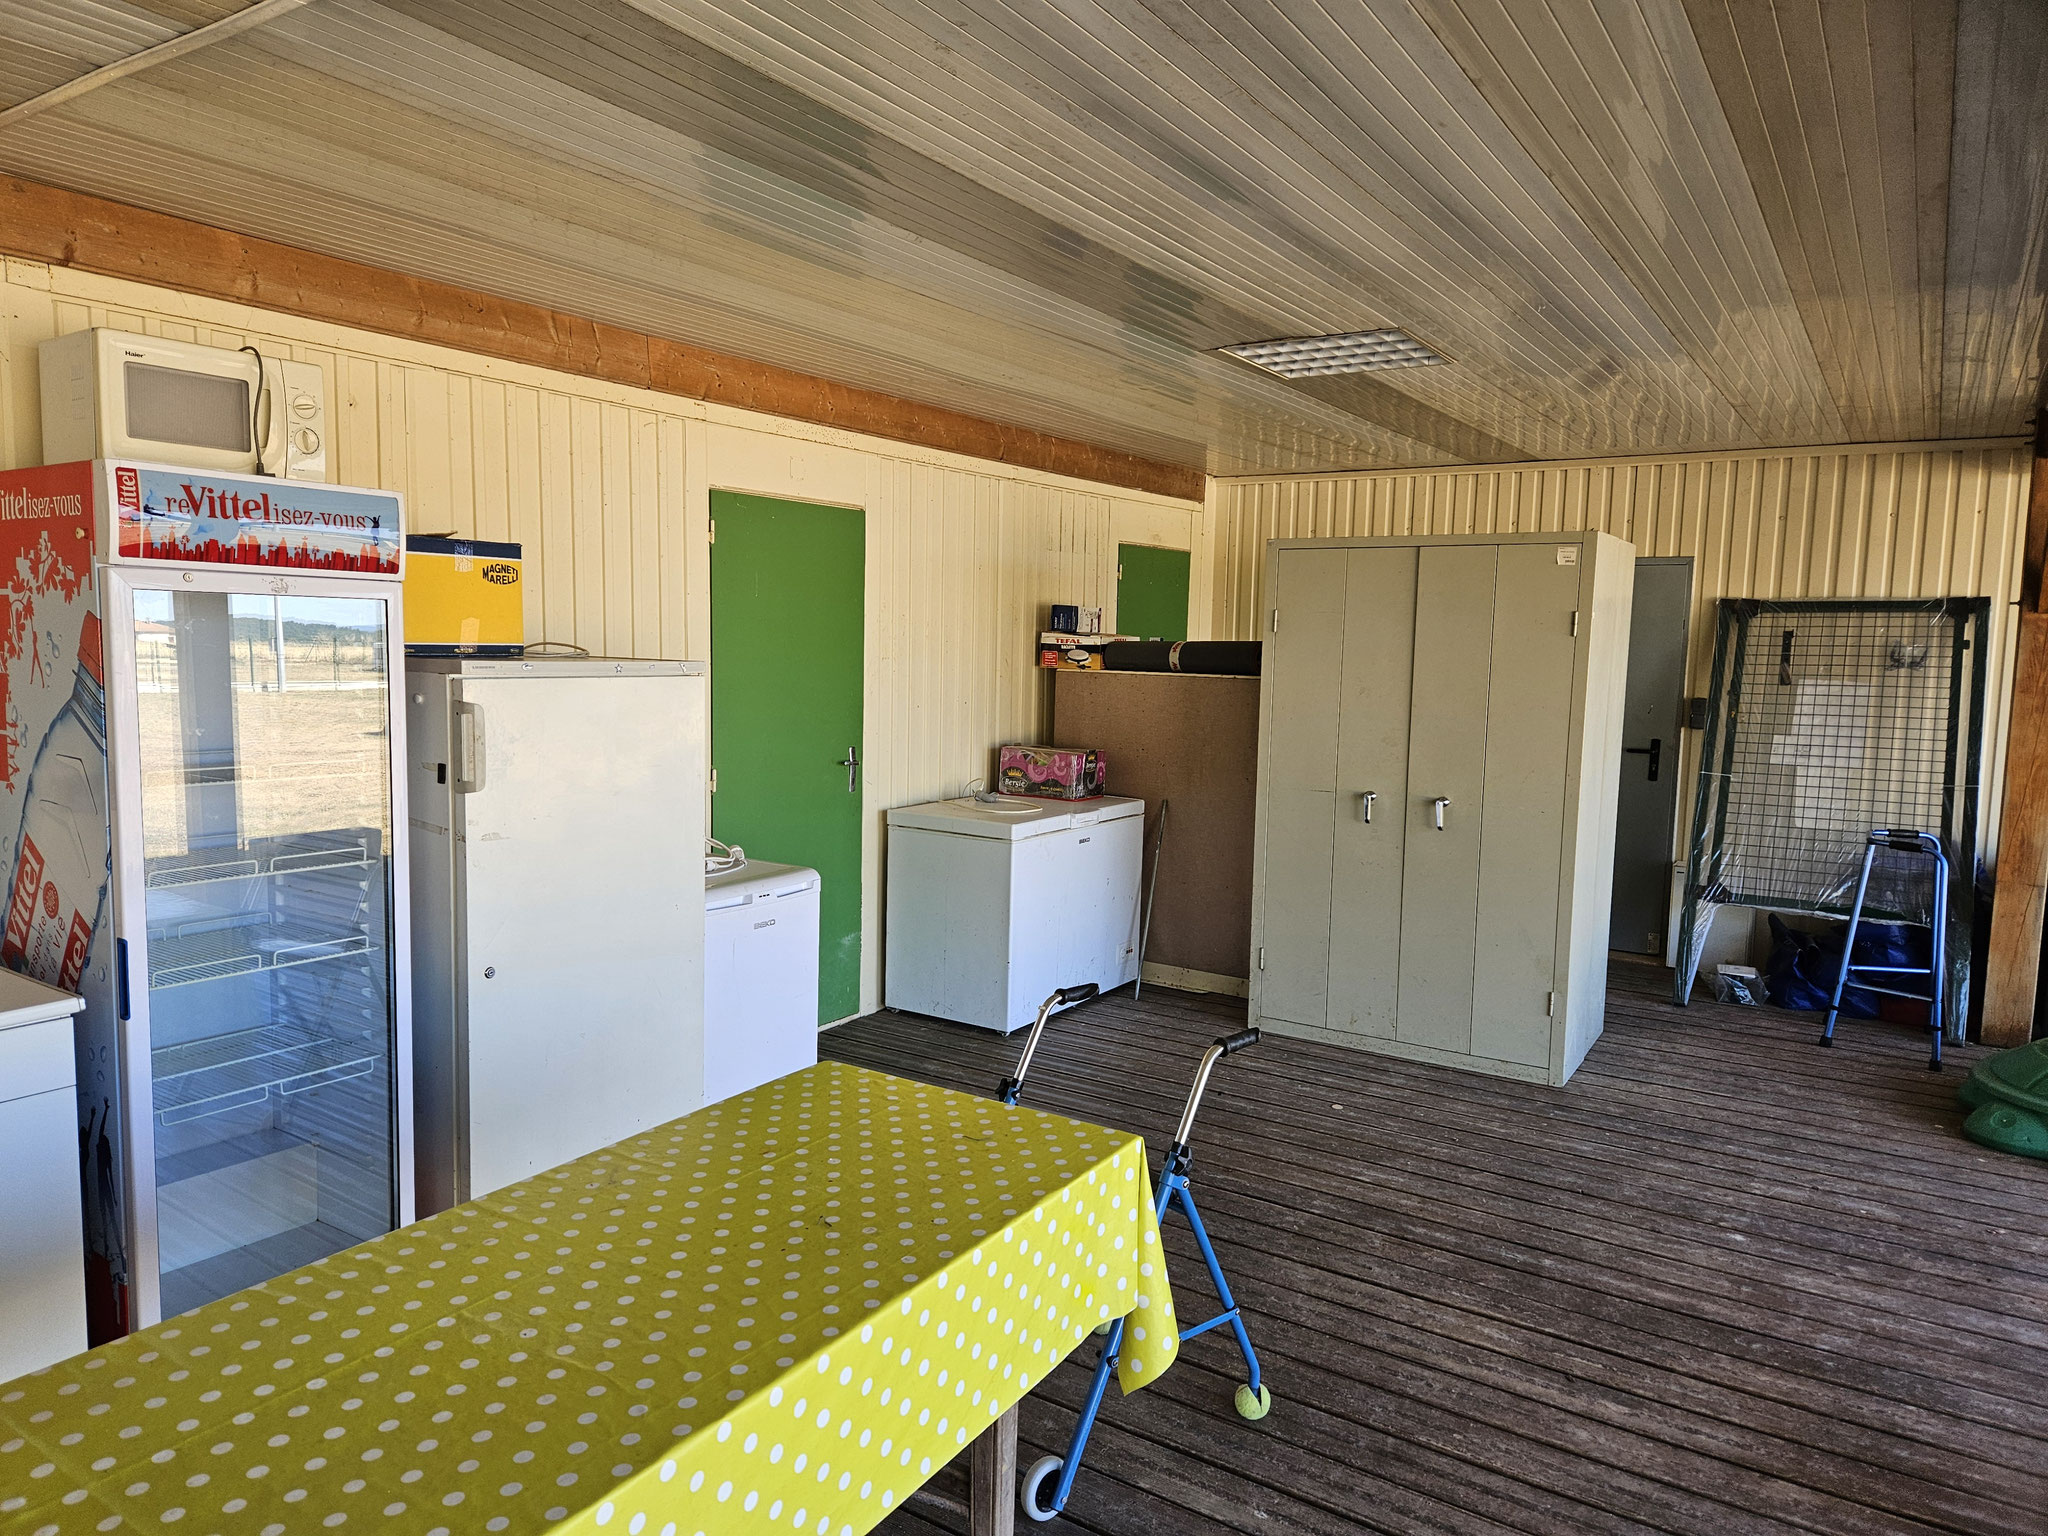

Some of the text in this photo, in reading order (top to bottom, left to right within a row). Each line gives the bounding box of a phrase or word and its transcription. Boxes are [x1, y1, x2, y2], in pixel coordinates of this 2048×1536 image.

[0, 487, 82, 520] ittelisez-vous
[117, 471, 137, 514] Vittel
[165, 484, 367, 532] reVittelisez-vous
[482, 563, 519, 576] MAGNETI
[482, 573, 519, 585] MARELLI
[7, 846, 41, 950] Vittel
[753, 919, 776, 930] BEKO
[62, 922, 89, 992] ttel
